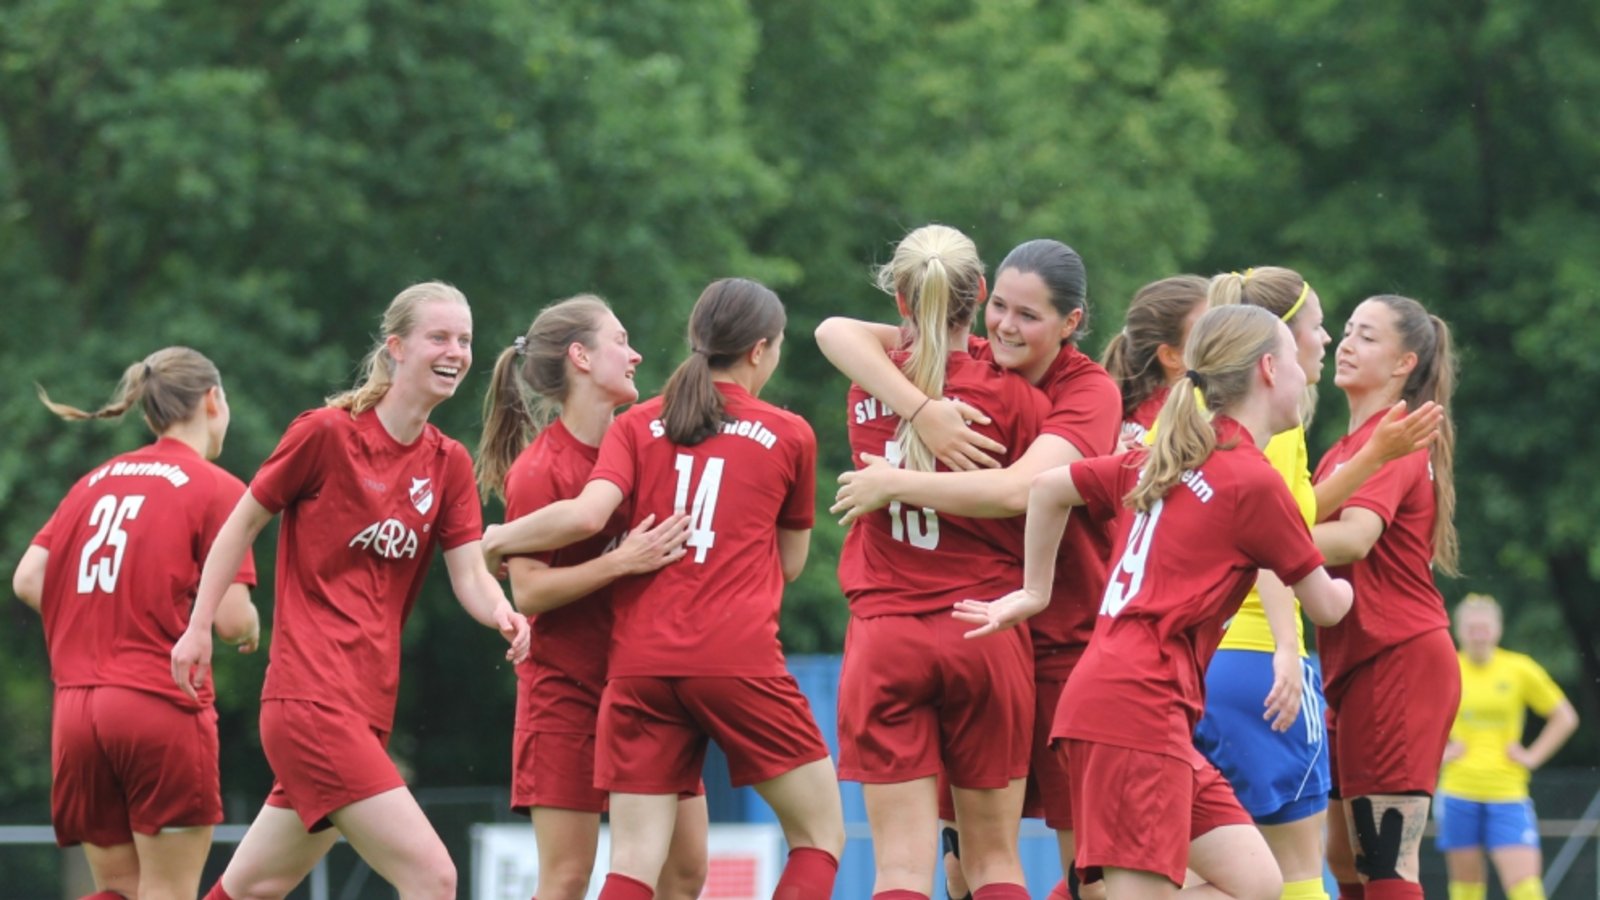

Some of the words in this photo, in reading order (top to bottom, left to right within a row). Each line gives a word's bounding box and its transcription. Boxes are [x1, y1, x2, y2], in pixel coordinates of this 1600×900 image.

[649, 419, 667, 438] S
[855, 397, 877, 425] SV
[348, 518, 419, 559] AERA
[672, 453, 725, 564] 14
[77, 494, 145, 594] 25
[1098, 498, 1164, 618] 19
